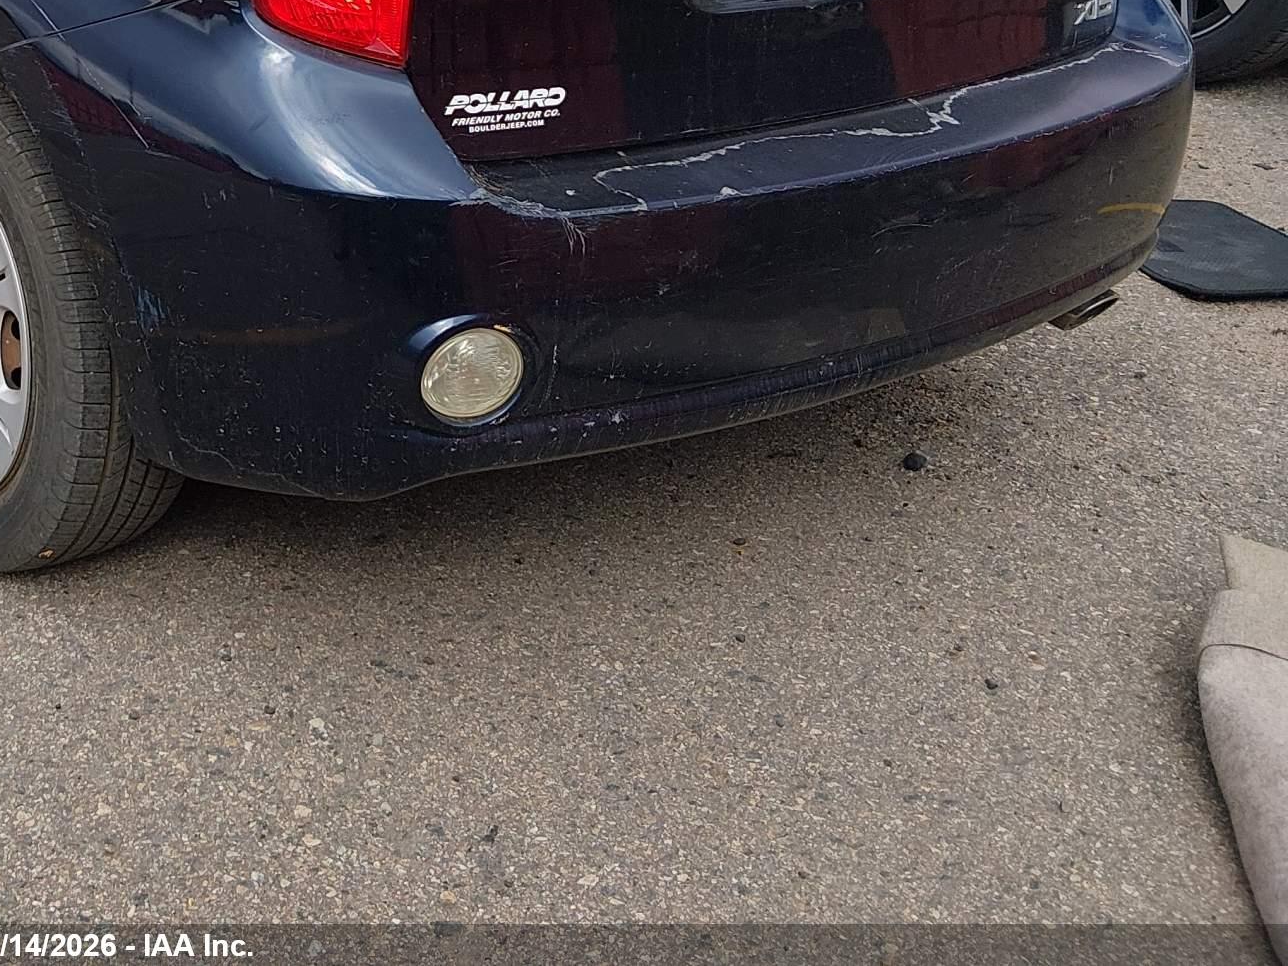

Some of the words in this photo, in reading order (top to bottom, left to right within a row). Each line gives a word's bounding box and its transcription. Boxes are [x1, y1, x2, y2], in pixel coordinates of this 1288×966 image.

[444, 87, 566, 116] POLLARD
[451, 114, 504, 127] FRIENDLY
[504, 110, 542, 122] MOTOR
[543, 108, 561, 118] CO.
[469, 119, 544, 133] BOULDERJEEP.COM
